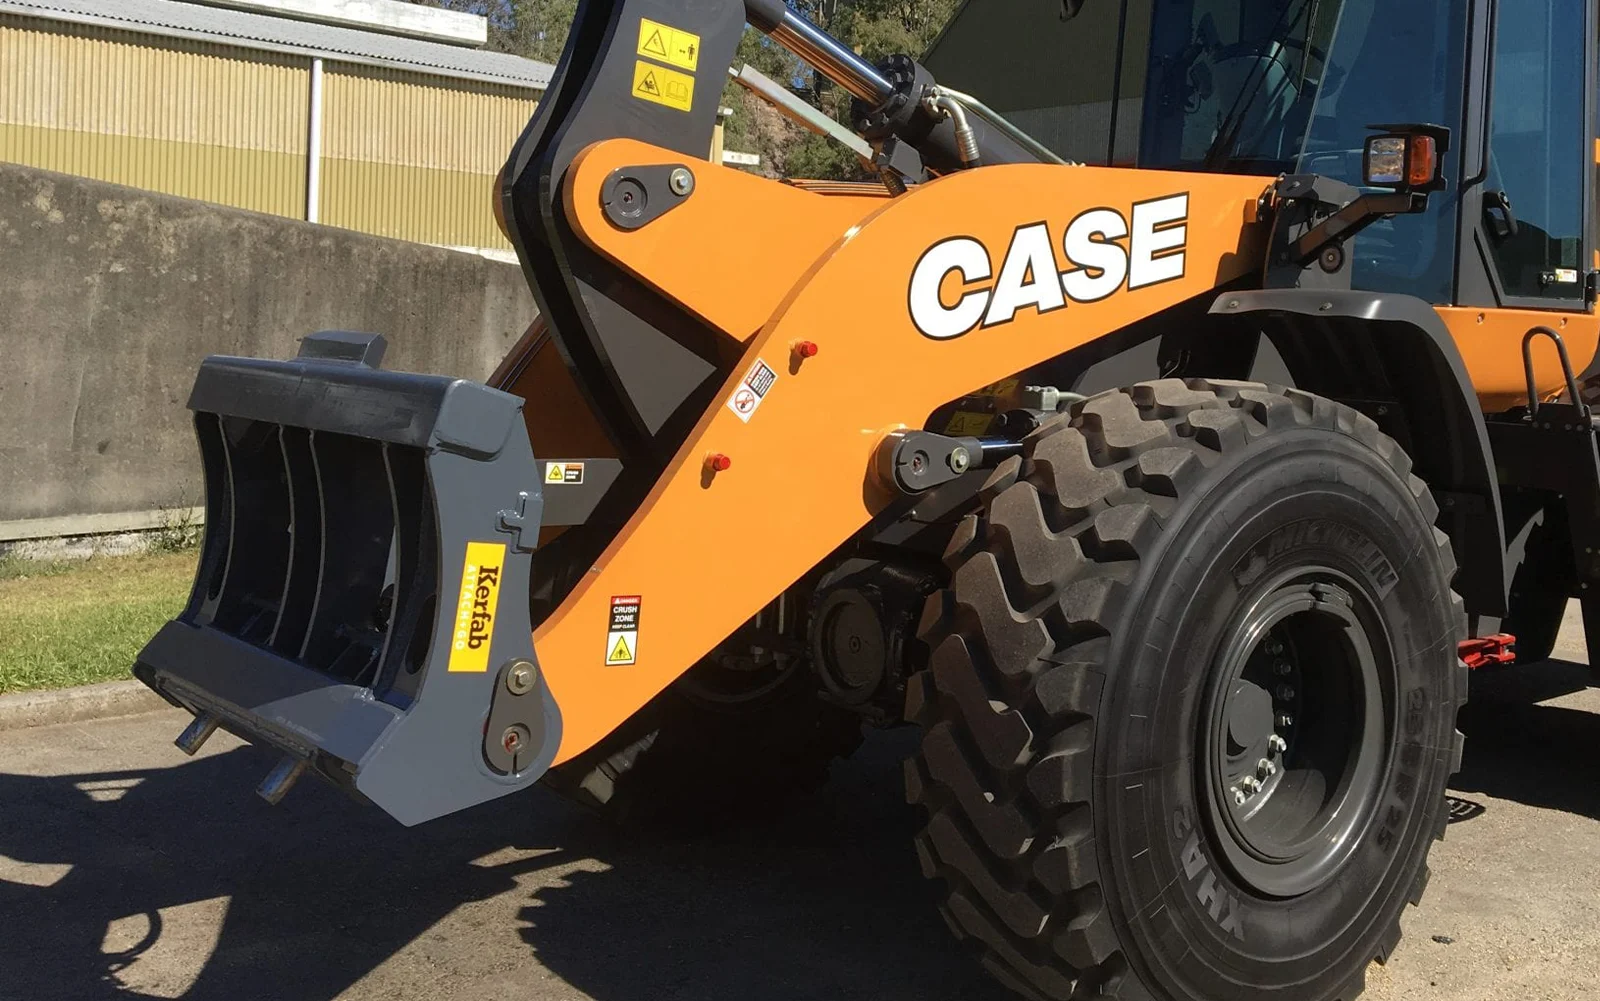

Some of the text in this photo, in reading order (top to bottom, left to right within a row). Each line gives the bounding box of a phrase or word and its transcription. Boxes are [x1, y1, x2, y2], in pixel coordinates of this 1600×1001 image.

[907, 191, 1190, 341] CASE
[468, 565, 499, 650] Kerfab
[1268, 519, 1396, 588] MICHELIN
[1174, 803, 1245, 941] XHA2
